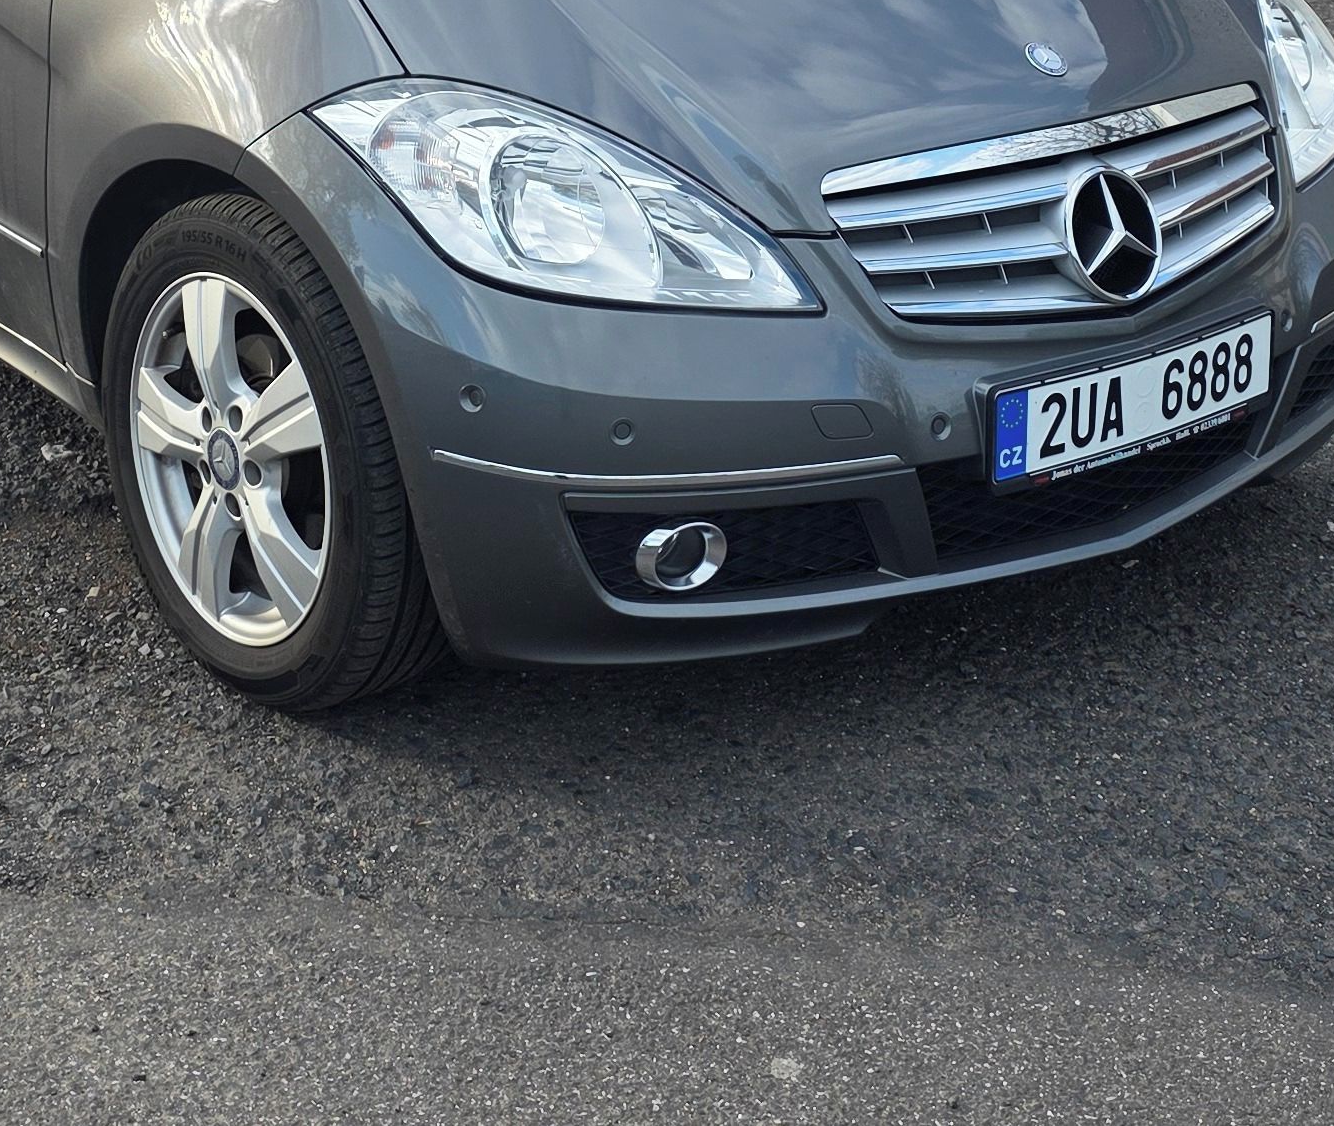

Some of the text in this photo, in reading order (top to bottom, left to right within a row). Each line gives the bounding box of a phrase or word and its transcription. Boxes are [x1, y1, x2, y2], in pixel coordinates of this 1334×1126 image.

[1040, 333, 1254, 459] 2UA 6888
[999, 445, 1023, 468] CZ
[1073, 463, 1086, 474] der
